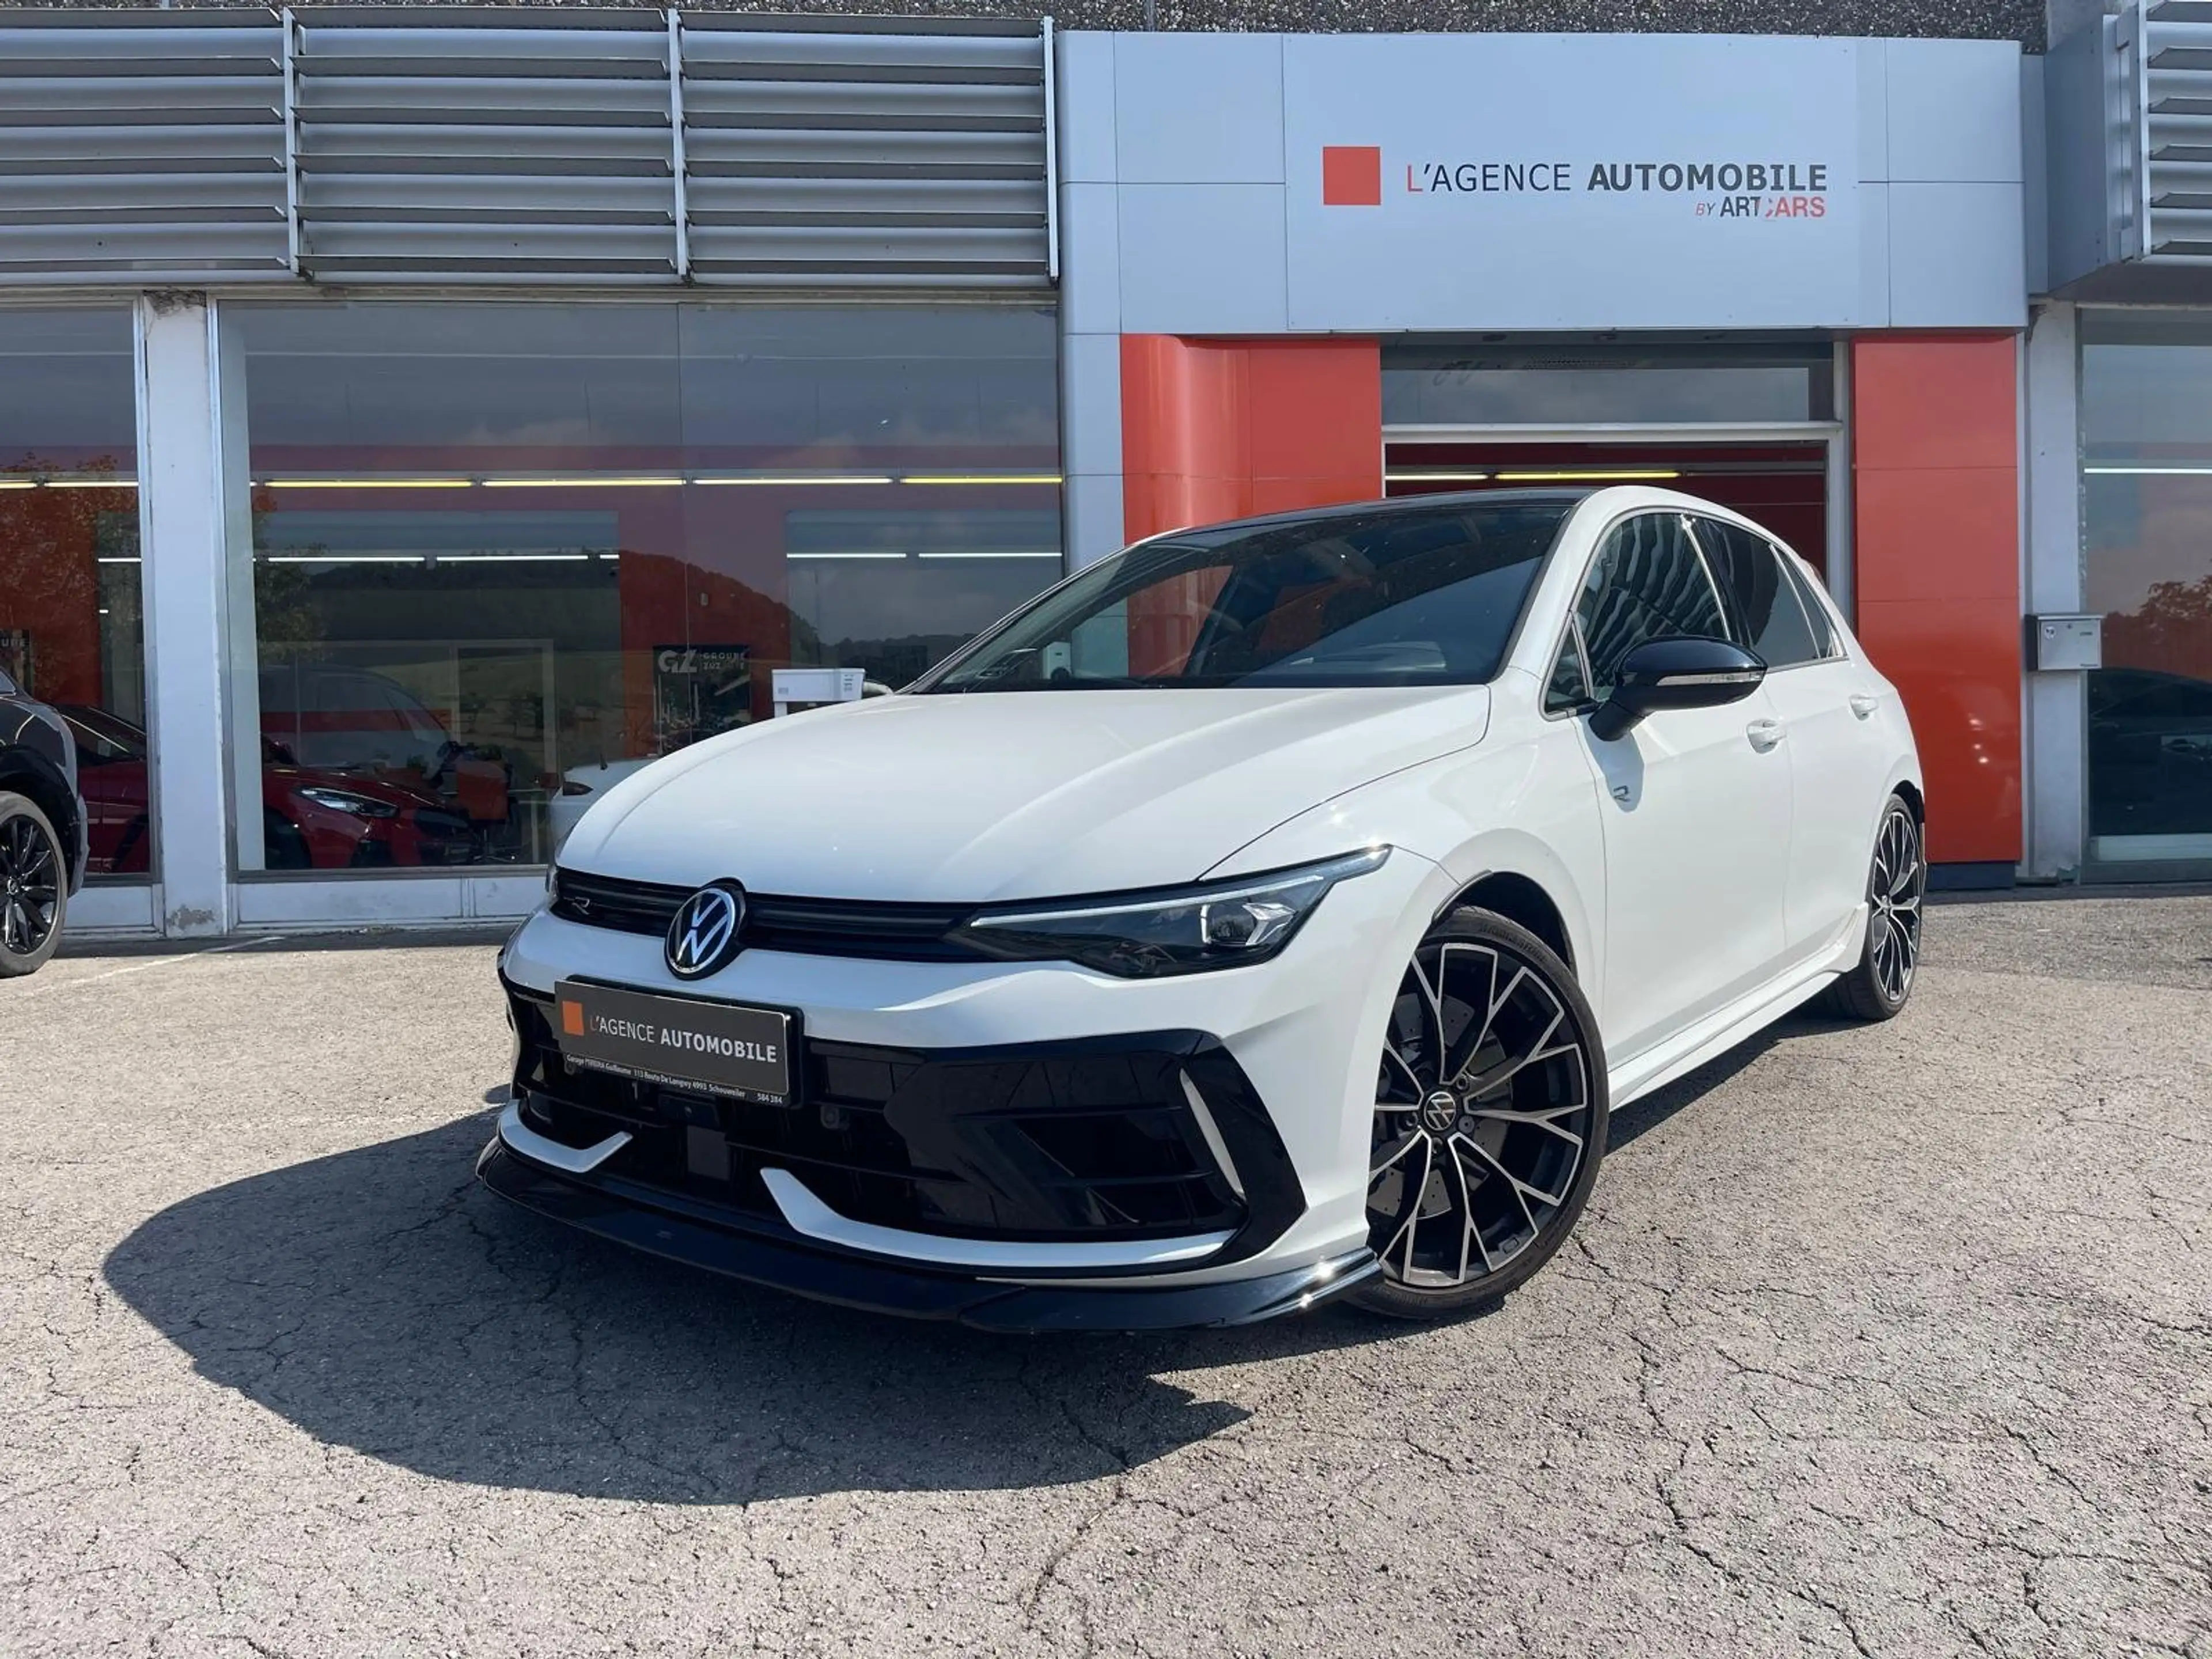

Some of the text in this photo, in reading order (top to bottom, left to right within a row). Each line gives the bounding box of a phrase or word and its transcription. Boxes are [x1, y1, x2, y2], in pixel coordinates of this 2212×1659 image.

[1406, 162, 1827, 192] L'AGENCE AUTOMOBILE
[1695, 202, 1716, 217] BY
[660, 1028, 777, 1063] AUTOMOBILE
